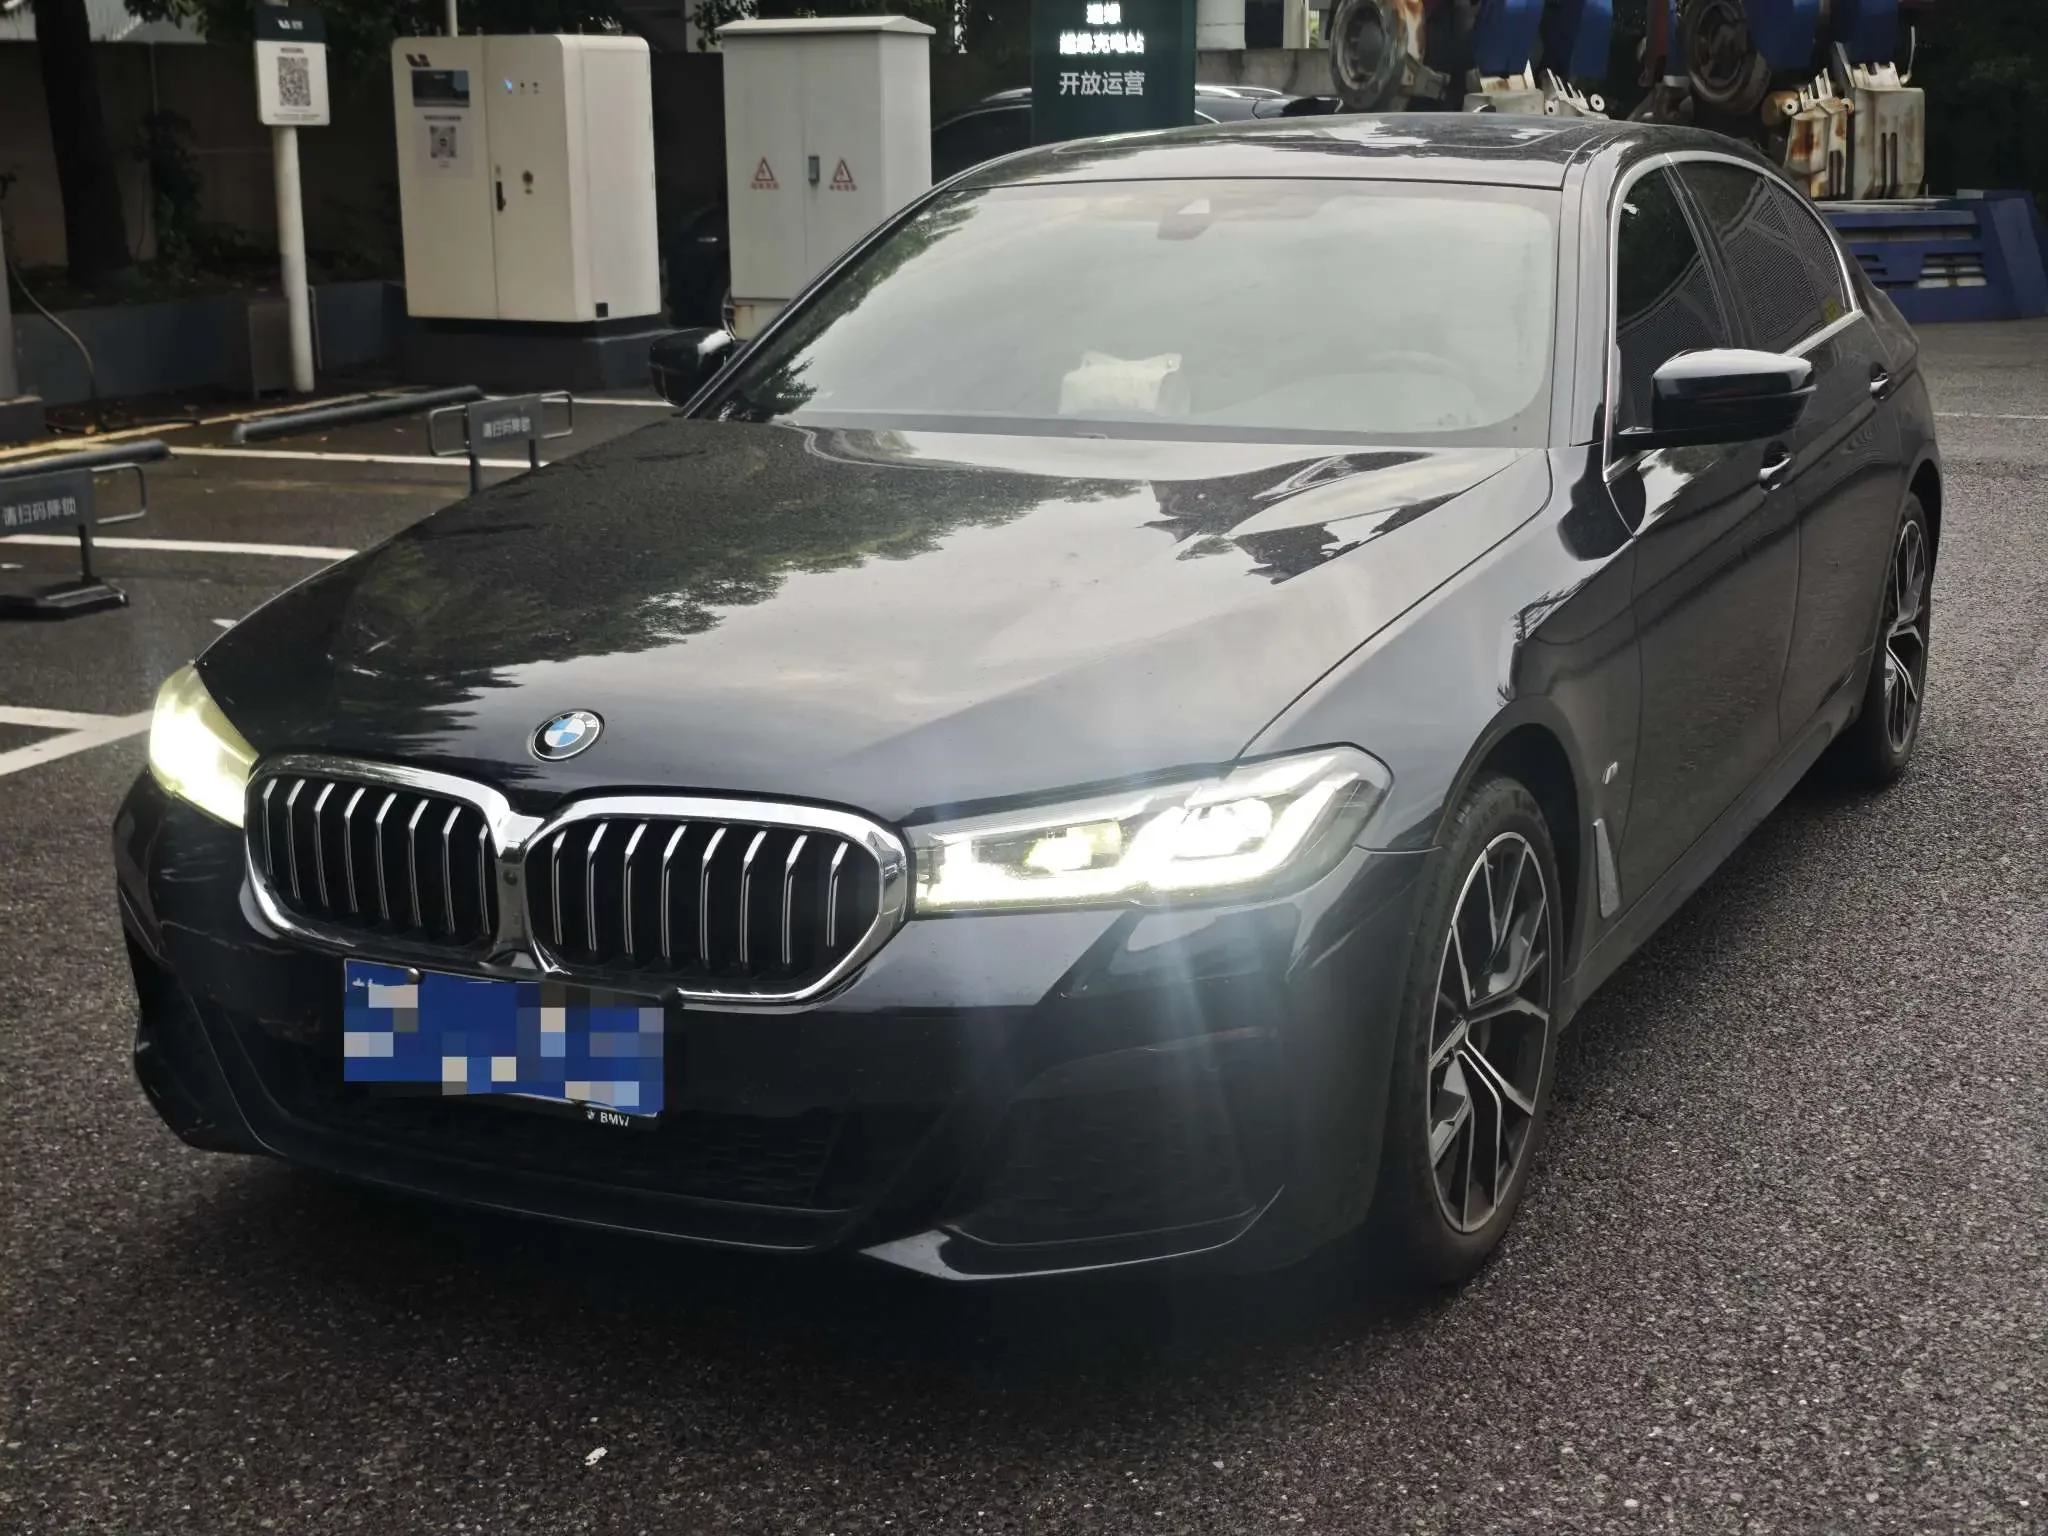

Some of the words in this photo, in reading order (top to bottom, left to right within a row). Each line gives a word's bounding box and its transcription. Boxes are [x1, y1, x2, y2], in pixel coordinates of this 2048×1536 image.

[1059, 71, 1145, 95] 开放运营
[600, 1112, 629, 1126] BMW
